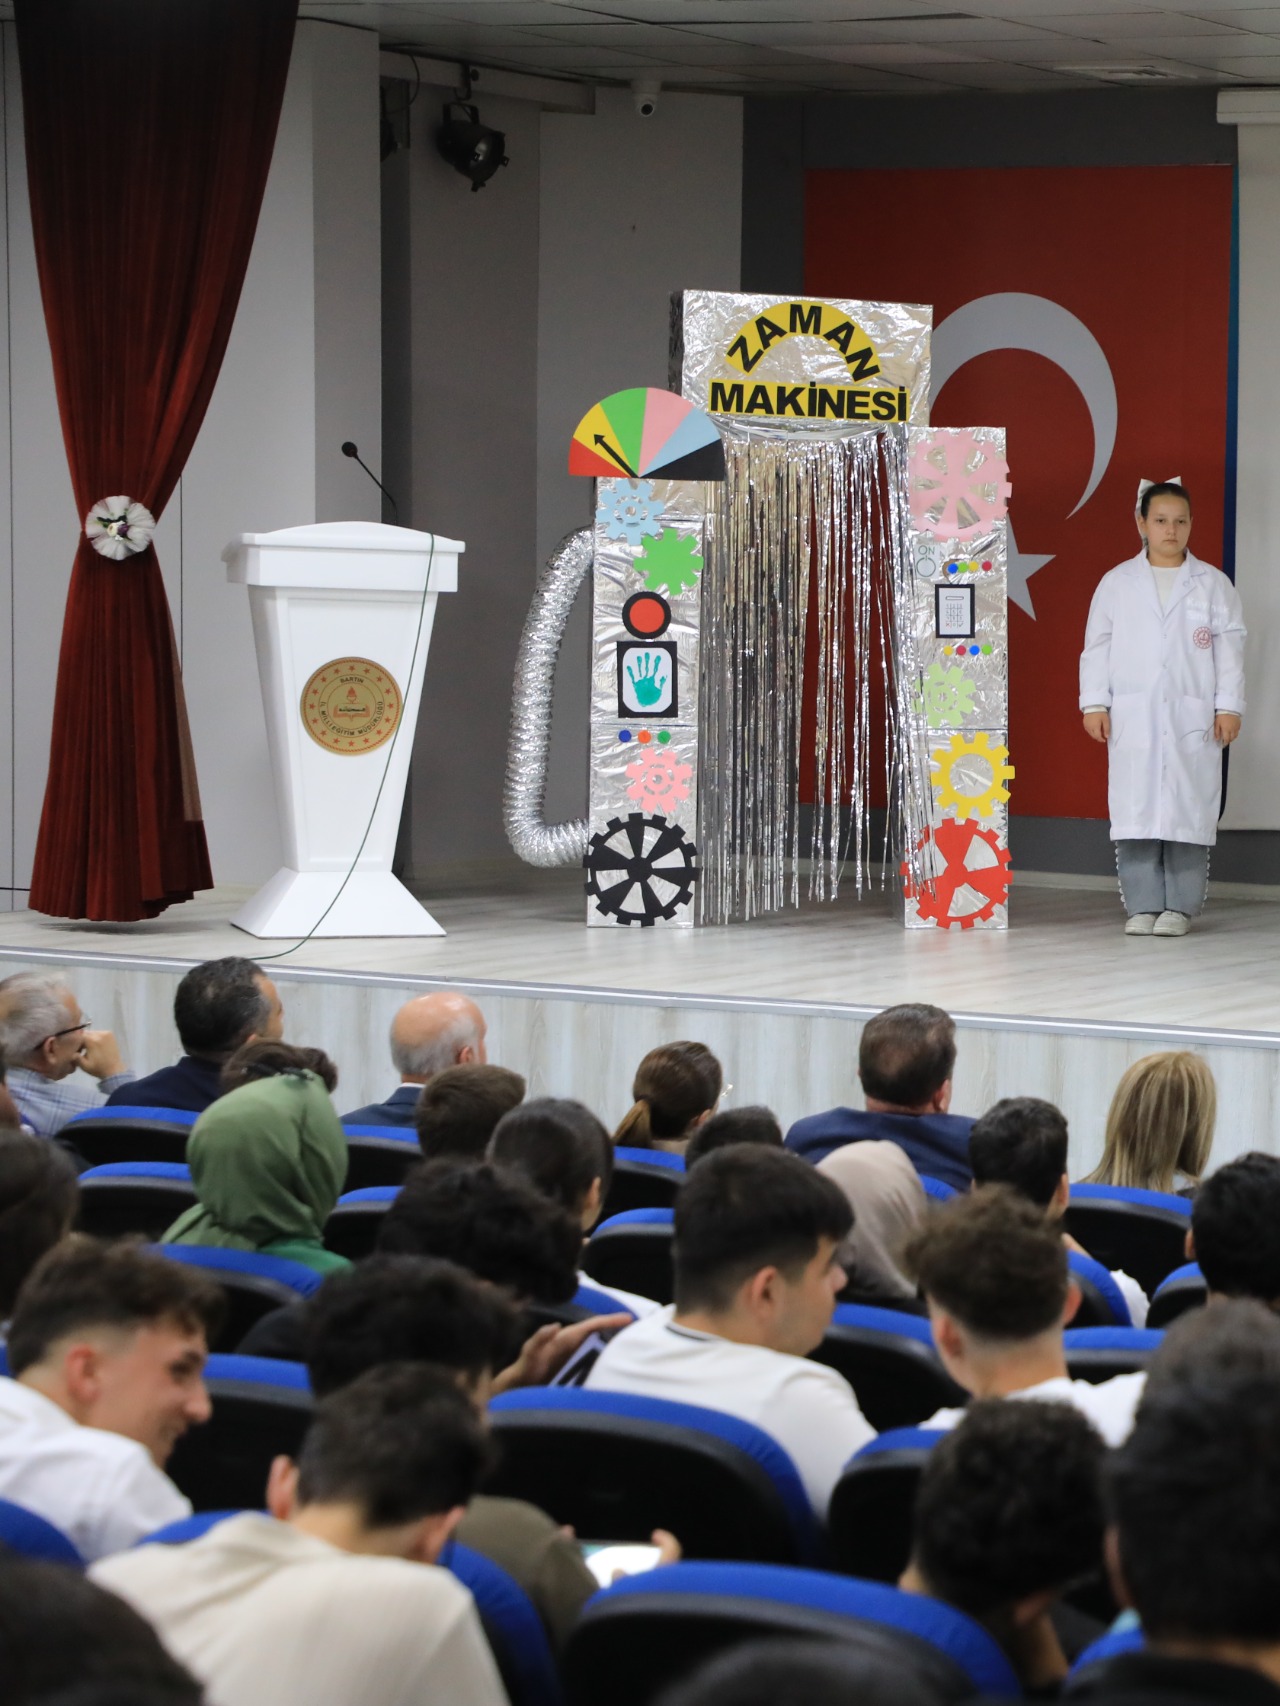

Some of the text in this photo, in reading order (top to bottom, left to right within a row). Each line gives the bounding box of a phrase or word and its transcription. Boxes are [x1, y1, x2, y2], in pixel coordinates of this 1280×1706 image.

[727, 303, 881, 383] ZAMAN
[710, 381, 907, 422] MAKİNESİ
[918, 545, 936, 556] ON
[340, 676, 364, 684] BARTIN
